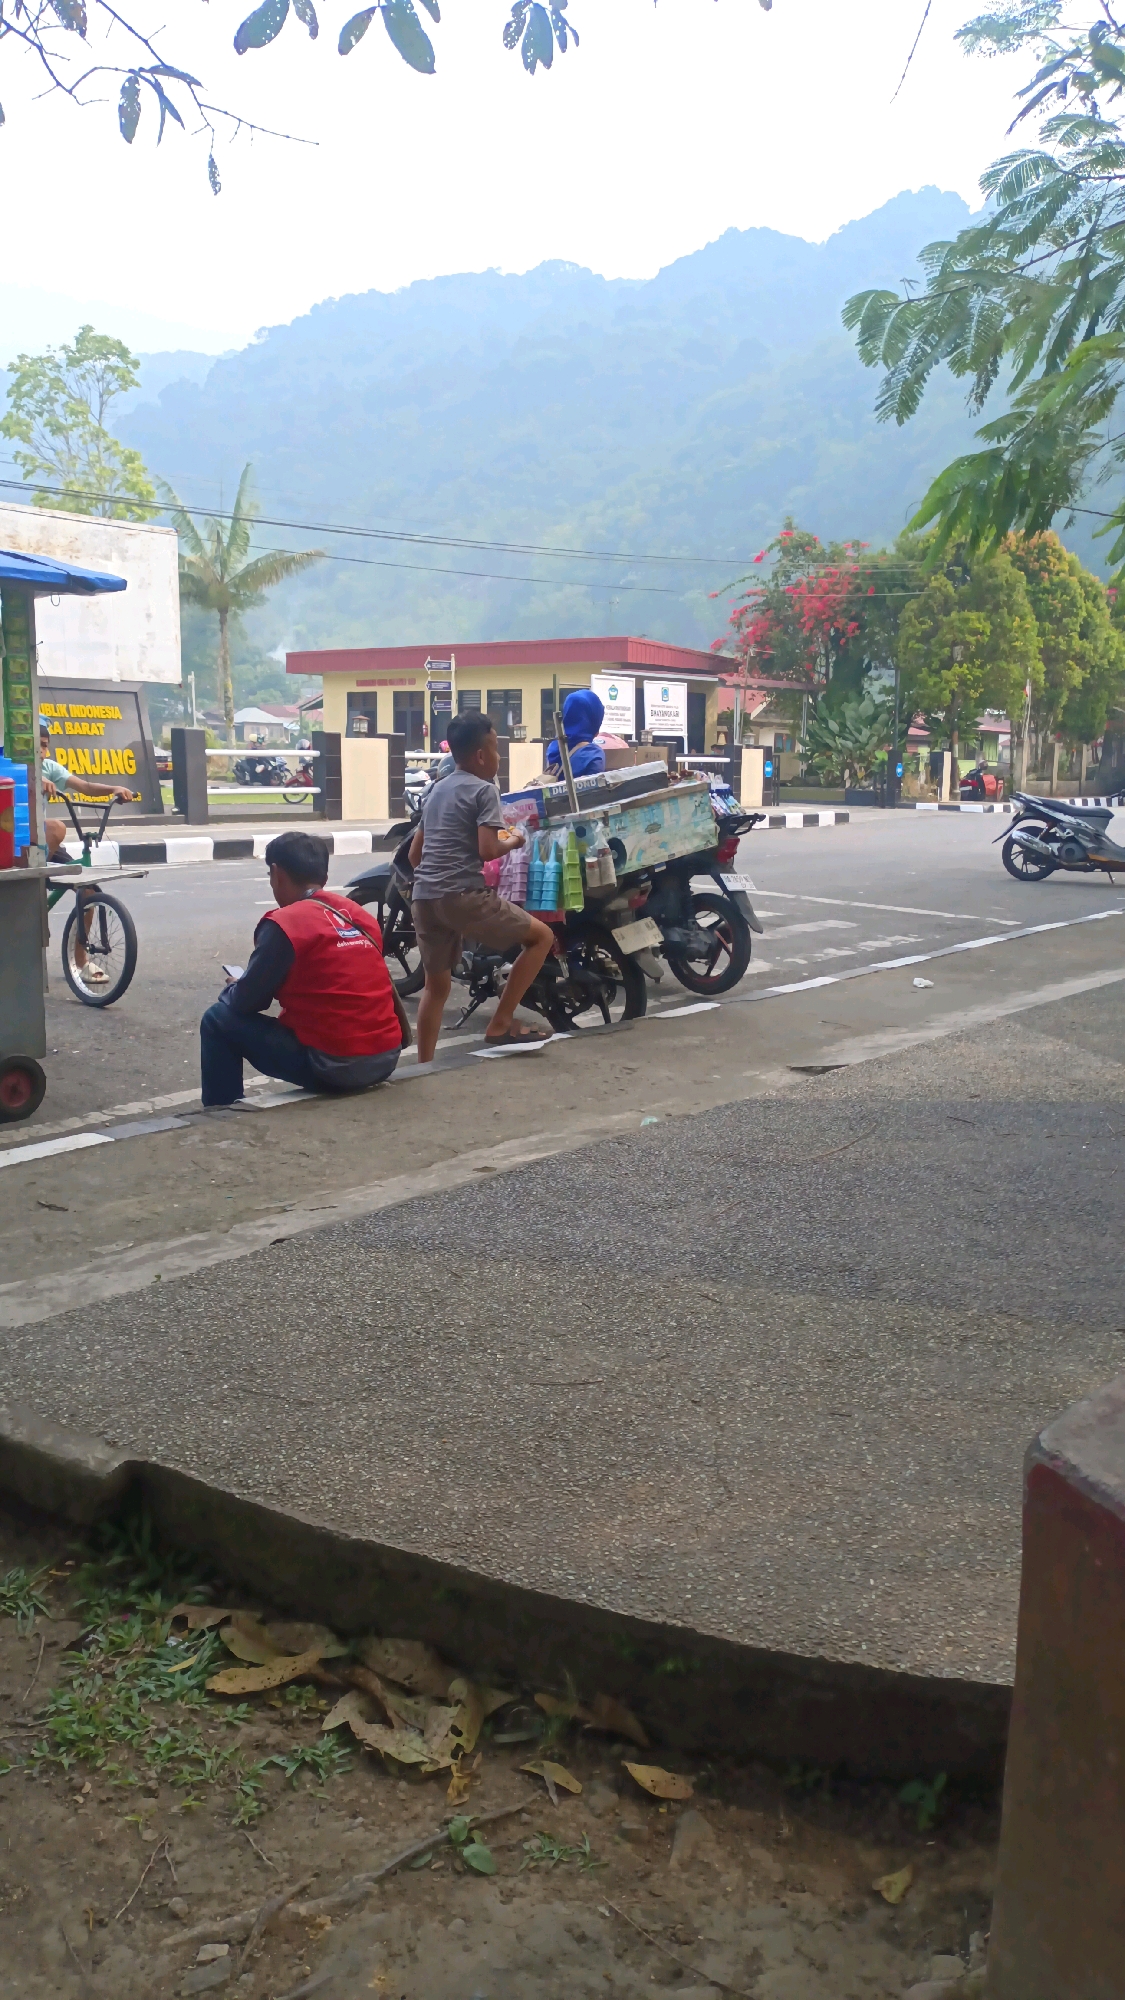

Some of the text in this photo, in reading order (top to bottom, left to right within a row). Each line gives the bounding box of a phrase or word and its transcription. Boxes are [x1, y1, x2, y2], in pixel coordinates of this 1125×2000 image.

[69, 704, 122, 719] INDONESIA
[65, 721, 105, 736] BARAT
[55, 748, 137, 775] PANJANG
[552, 779, 597, 795] DIAOND
